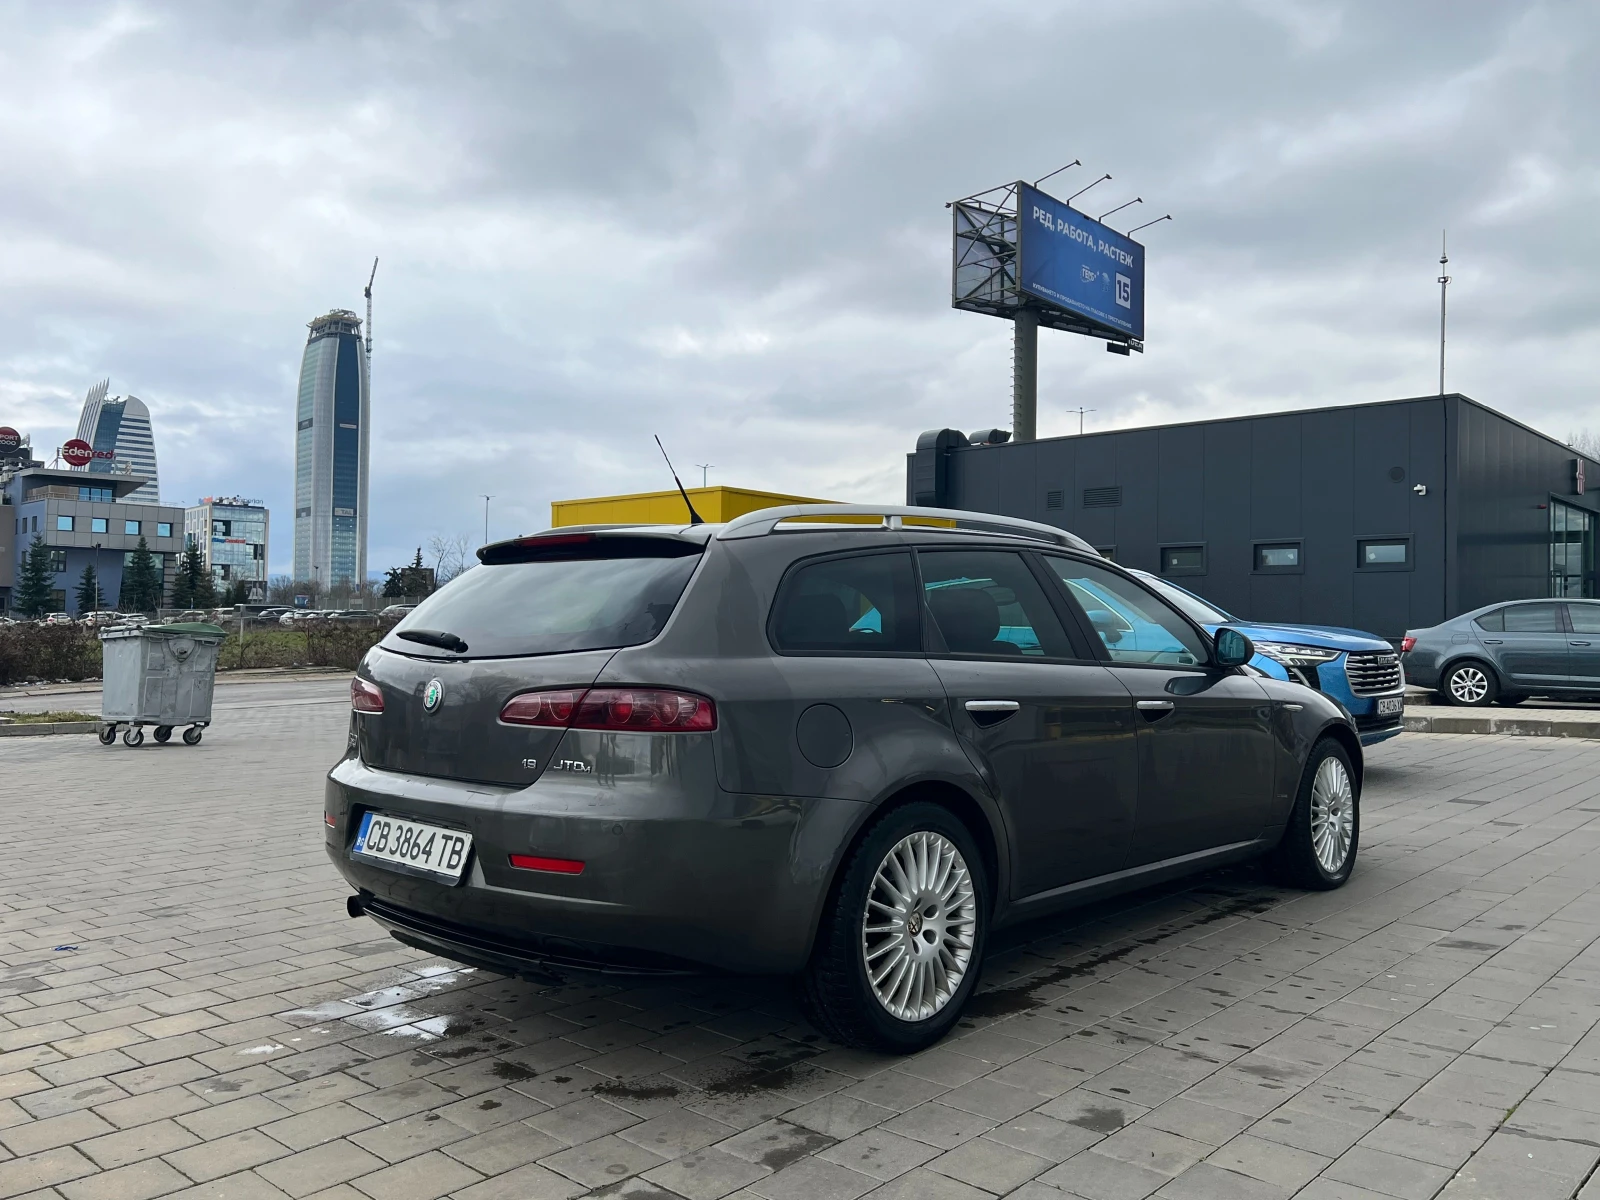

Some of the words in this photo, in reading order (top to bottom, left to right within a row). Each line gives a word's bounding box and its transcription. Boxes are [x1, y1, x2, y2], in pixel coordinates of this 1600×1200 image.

[1033, 205, 1055, 231] РЕД,
[1057, 218, 1097, 252] РАБОТА,
[1098, 239, 1134, 268] РАСТЕЖ
[1117, 279, 1130, 303] 15
[62, 445, 115, 460] Edenred
